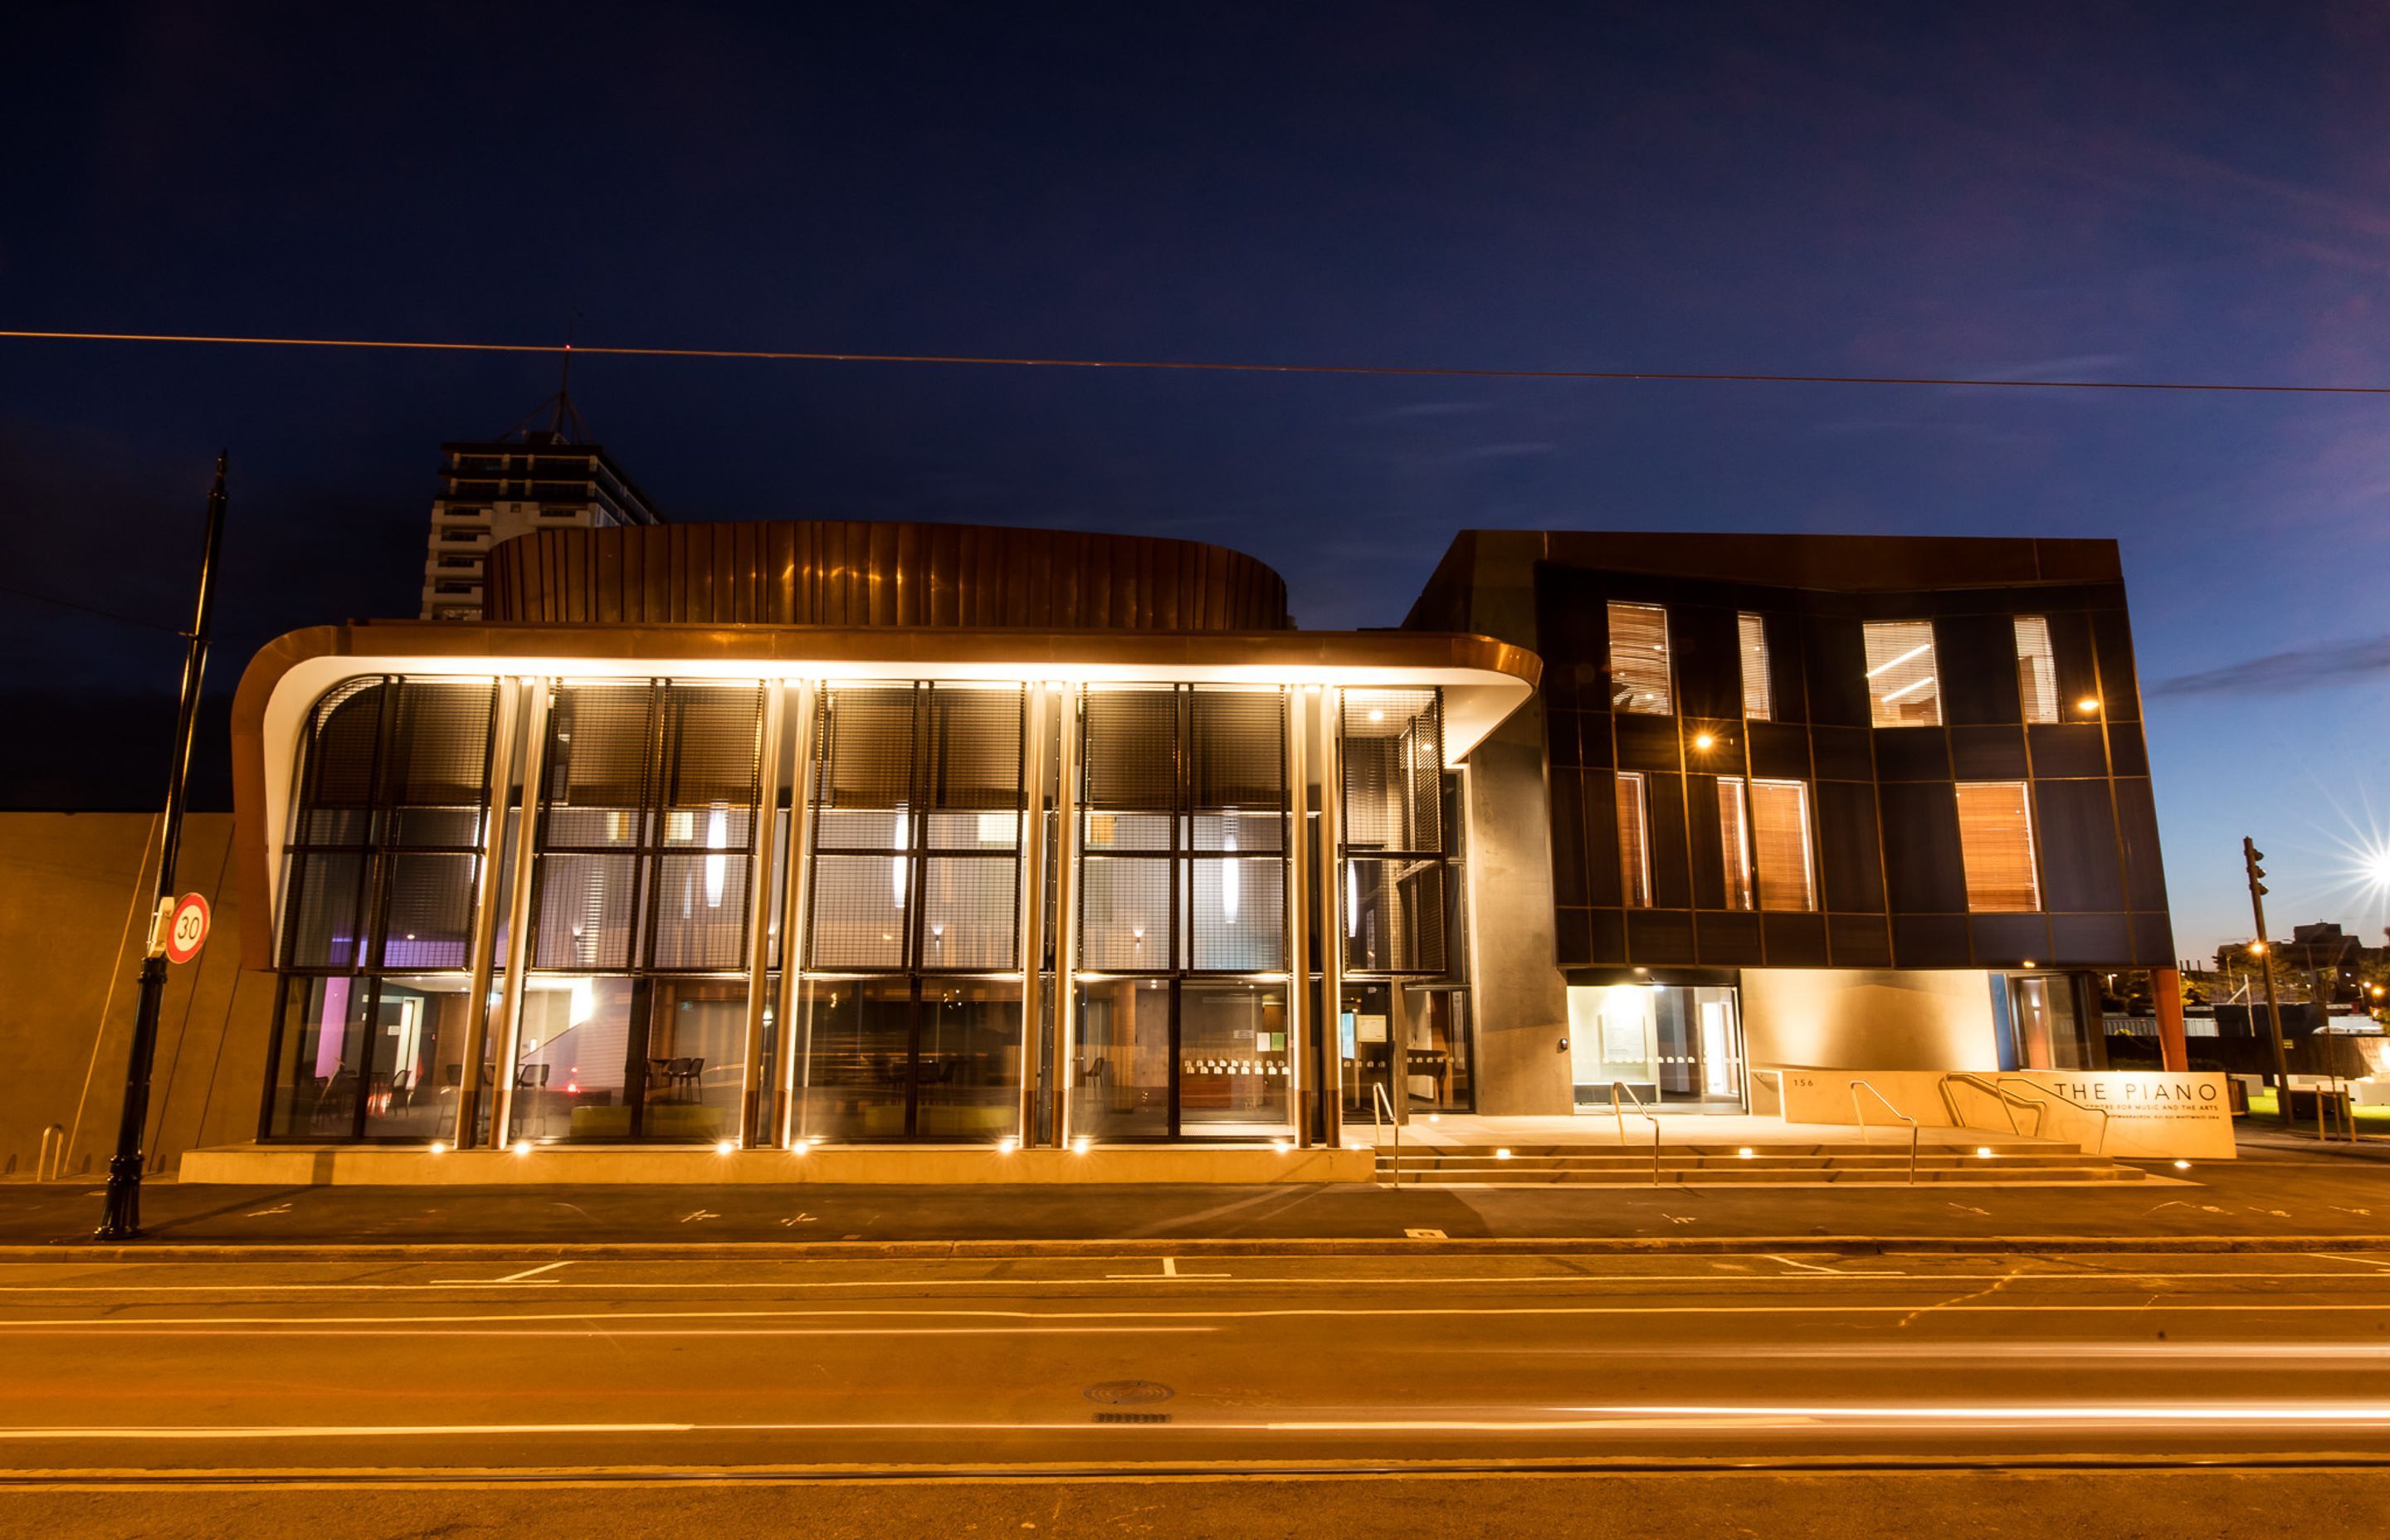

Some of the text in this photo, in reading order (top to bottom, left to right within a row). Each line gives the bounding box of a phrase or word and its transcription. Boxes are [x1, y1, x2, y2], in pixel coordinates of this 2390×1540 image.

[178, 916, 200, 940] 30
[1794, 1079, 1813, 1087] 156
[2053, 1083, 2217, 1101] THE PIANO
